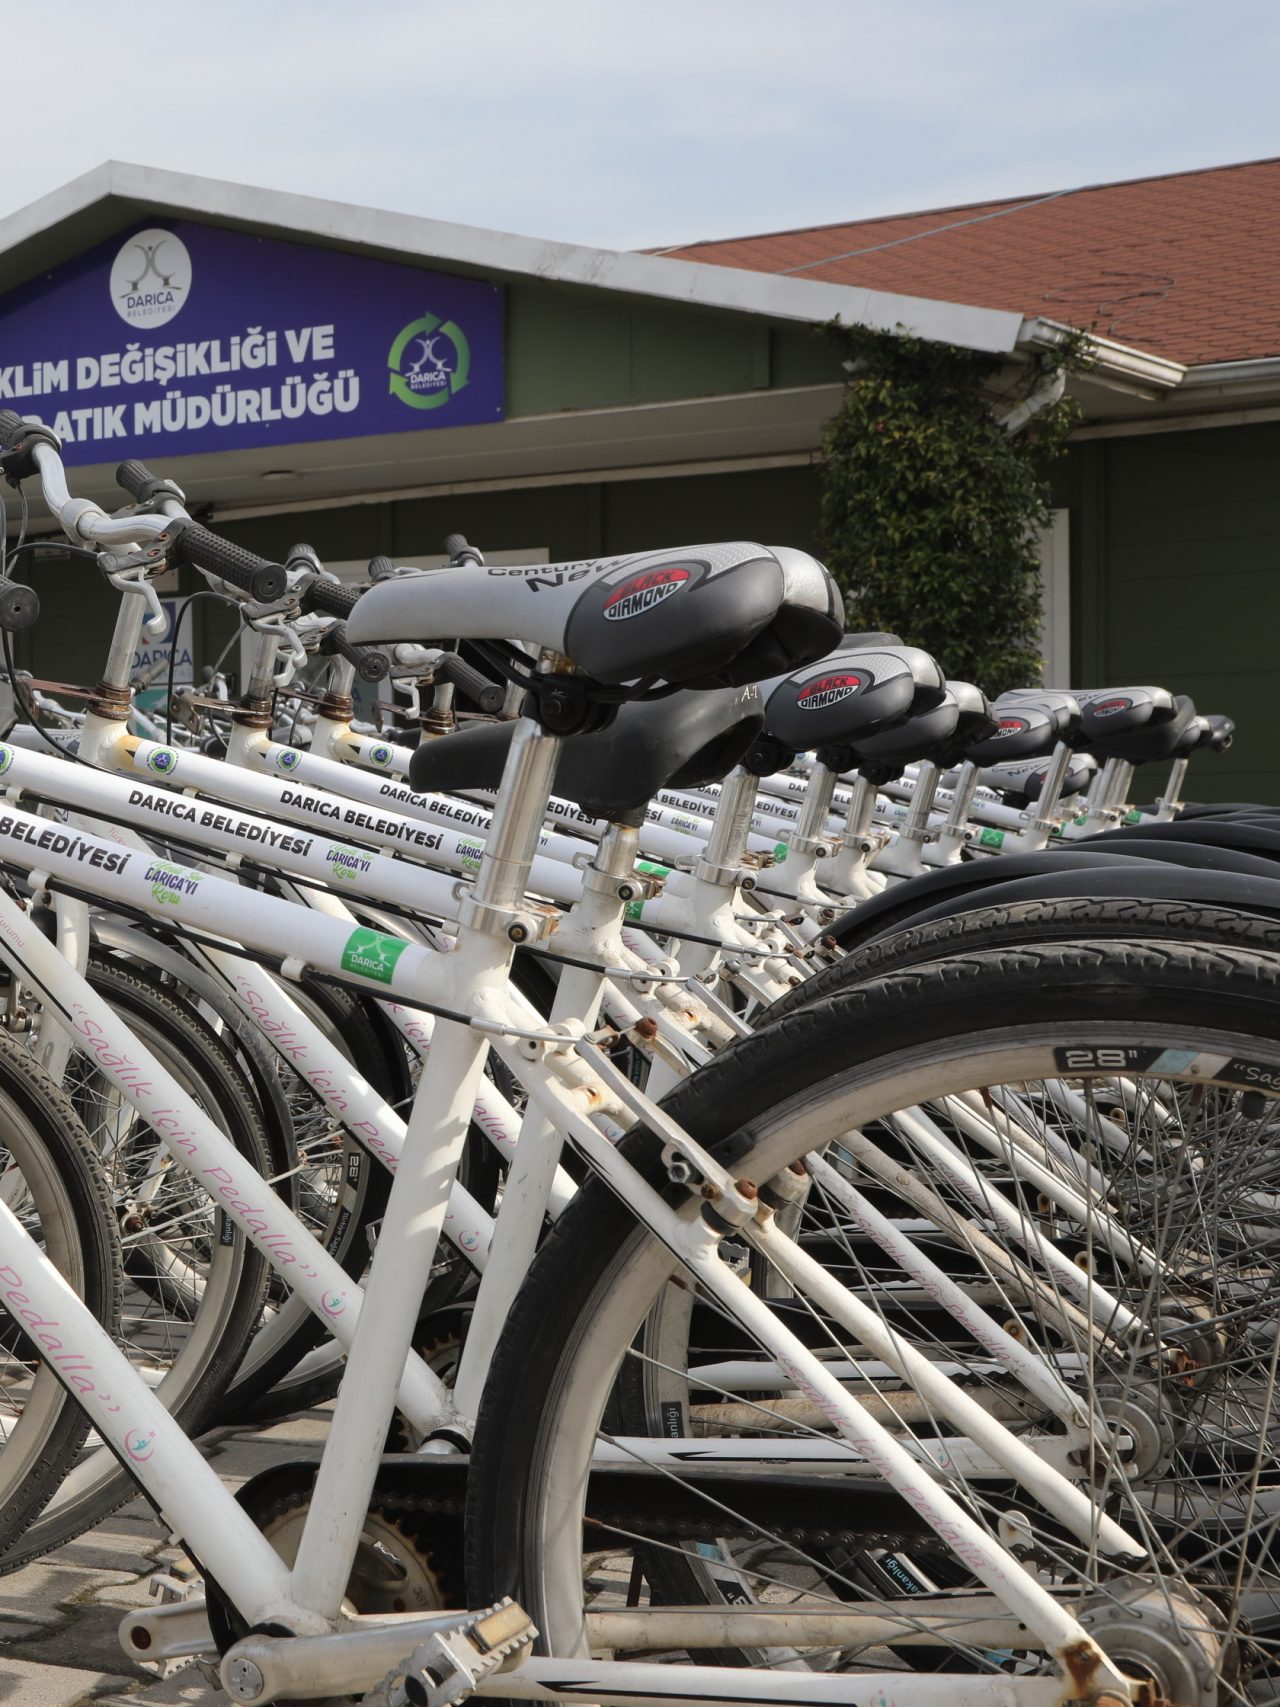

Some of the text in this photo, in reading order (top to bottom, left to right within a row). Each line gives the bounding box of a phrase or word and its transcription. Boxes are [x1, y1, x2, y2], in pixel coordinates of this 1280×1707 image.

[127, 291, 174, 309] DARICA
[77, 326, 277, 390] DEĞİŞİKLİĞİ
[285, 325, 334, 363] VE
[134, 369, 360, 436] MÜDÜRLÜĞÜ
[488, 560, 598, 577] Century
[607, 582, 679, 618] DIAMOND
[800, 686, 853, 708] DIAMOND
[809, 676, 851, 696] BLACK
[380, 784, 493, 831] DARICA BELEDİYE
[661, 792, 716, 816] BELEDİYE
[128, 790, 196, 823] DARICA
[200, 811, 314, 857] BELEDİYESİ
[280, 790, 445, 850] DARICA BELEDİYESİ
[350, 954, 384, 971] DARICA
[1065, 1049, 1138, 1069] 28"
[884, 1557, 923, 1595] akanlığı
